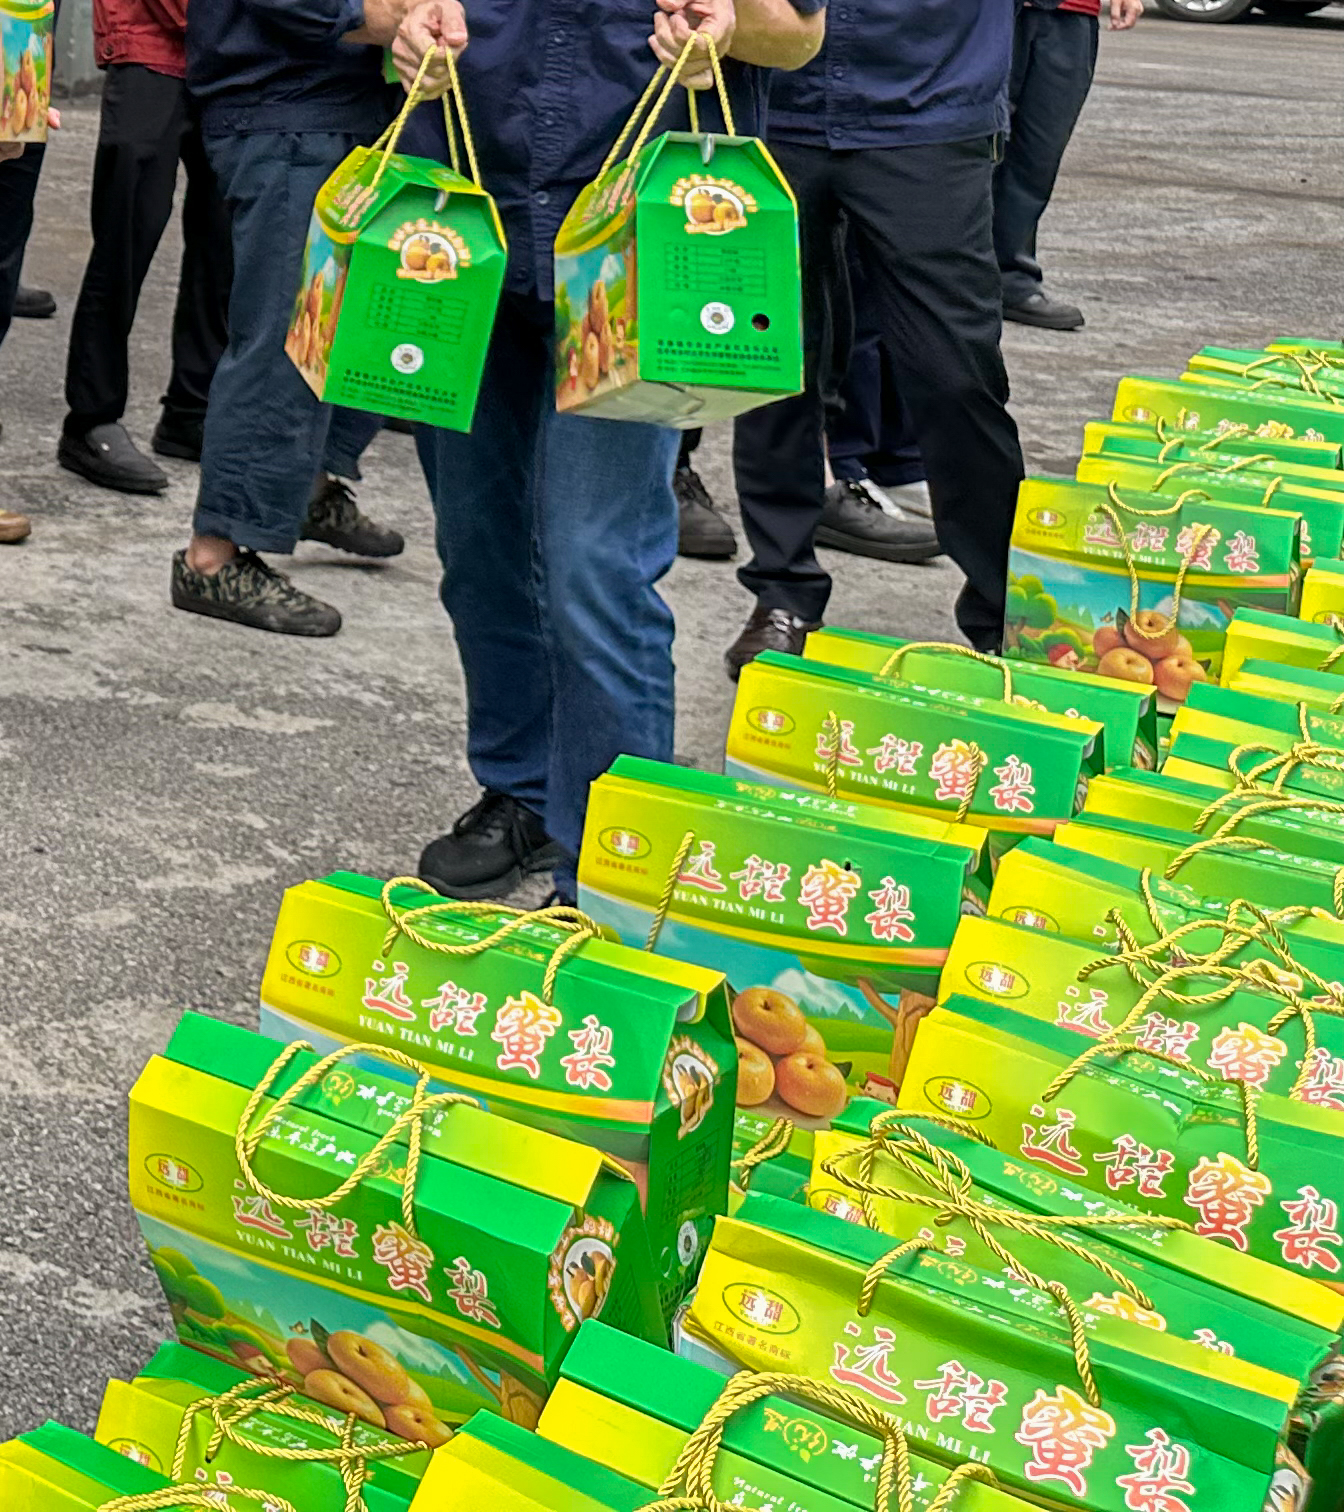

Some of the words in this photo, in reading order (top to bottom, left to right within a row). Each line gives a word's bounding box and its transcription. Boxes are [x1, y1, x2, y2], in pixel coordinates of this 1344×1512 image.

[1113, 551, 1136, 561] TIN
[814, 761, 845, 779] YUN
[850, 771, 878, 787] TIAN
[882, 778, 898, 792] MI
[902, 783, 916, 796] LI
[815, 719, 1036, 814] 远甜蜜梨
[673, 889, 709, 908] YUAN
[712, 897, 744, 915] TIAN
[748, 906, 766, 920] MI
[770, 910, 785, 924] LI
[676, 840, 916, 943] 远甜蜜梨
[359, 1015, 393, 1034] YUAN
[400, 1027, 432, 1046] TIAN
[437, 1039, 455, 1055] MI
[459, 1046, 474, 1062] LI
[362, 959, 616, 1092] 远甜蜜梨
[1019, 1103, 1342, 1272] 远甜蜜梨
[231, 1178, 502, 1329] 远甜蜜梨
[235, 1228, 276, 1252] YUAN
[281, 1244, 317, 1266] TIAN
[322, 1258, 342, 1274] MI
[347, 1266, 364, 1282] LI
[739, 1288, 784, 1322] 远甜
[713, 1320, 791, 1361] 江西省著名商标
[829, 1321, 1196, 1512] 远甜蜜梨
[936, 1432, 962, 1454] MI
[969, 1445, 991, 1464] LI
[734, 1476, 785, 1505] Natural
